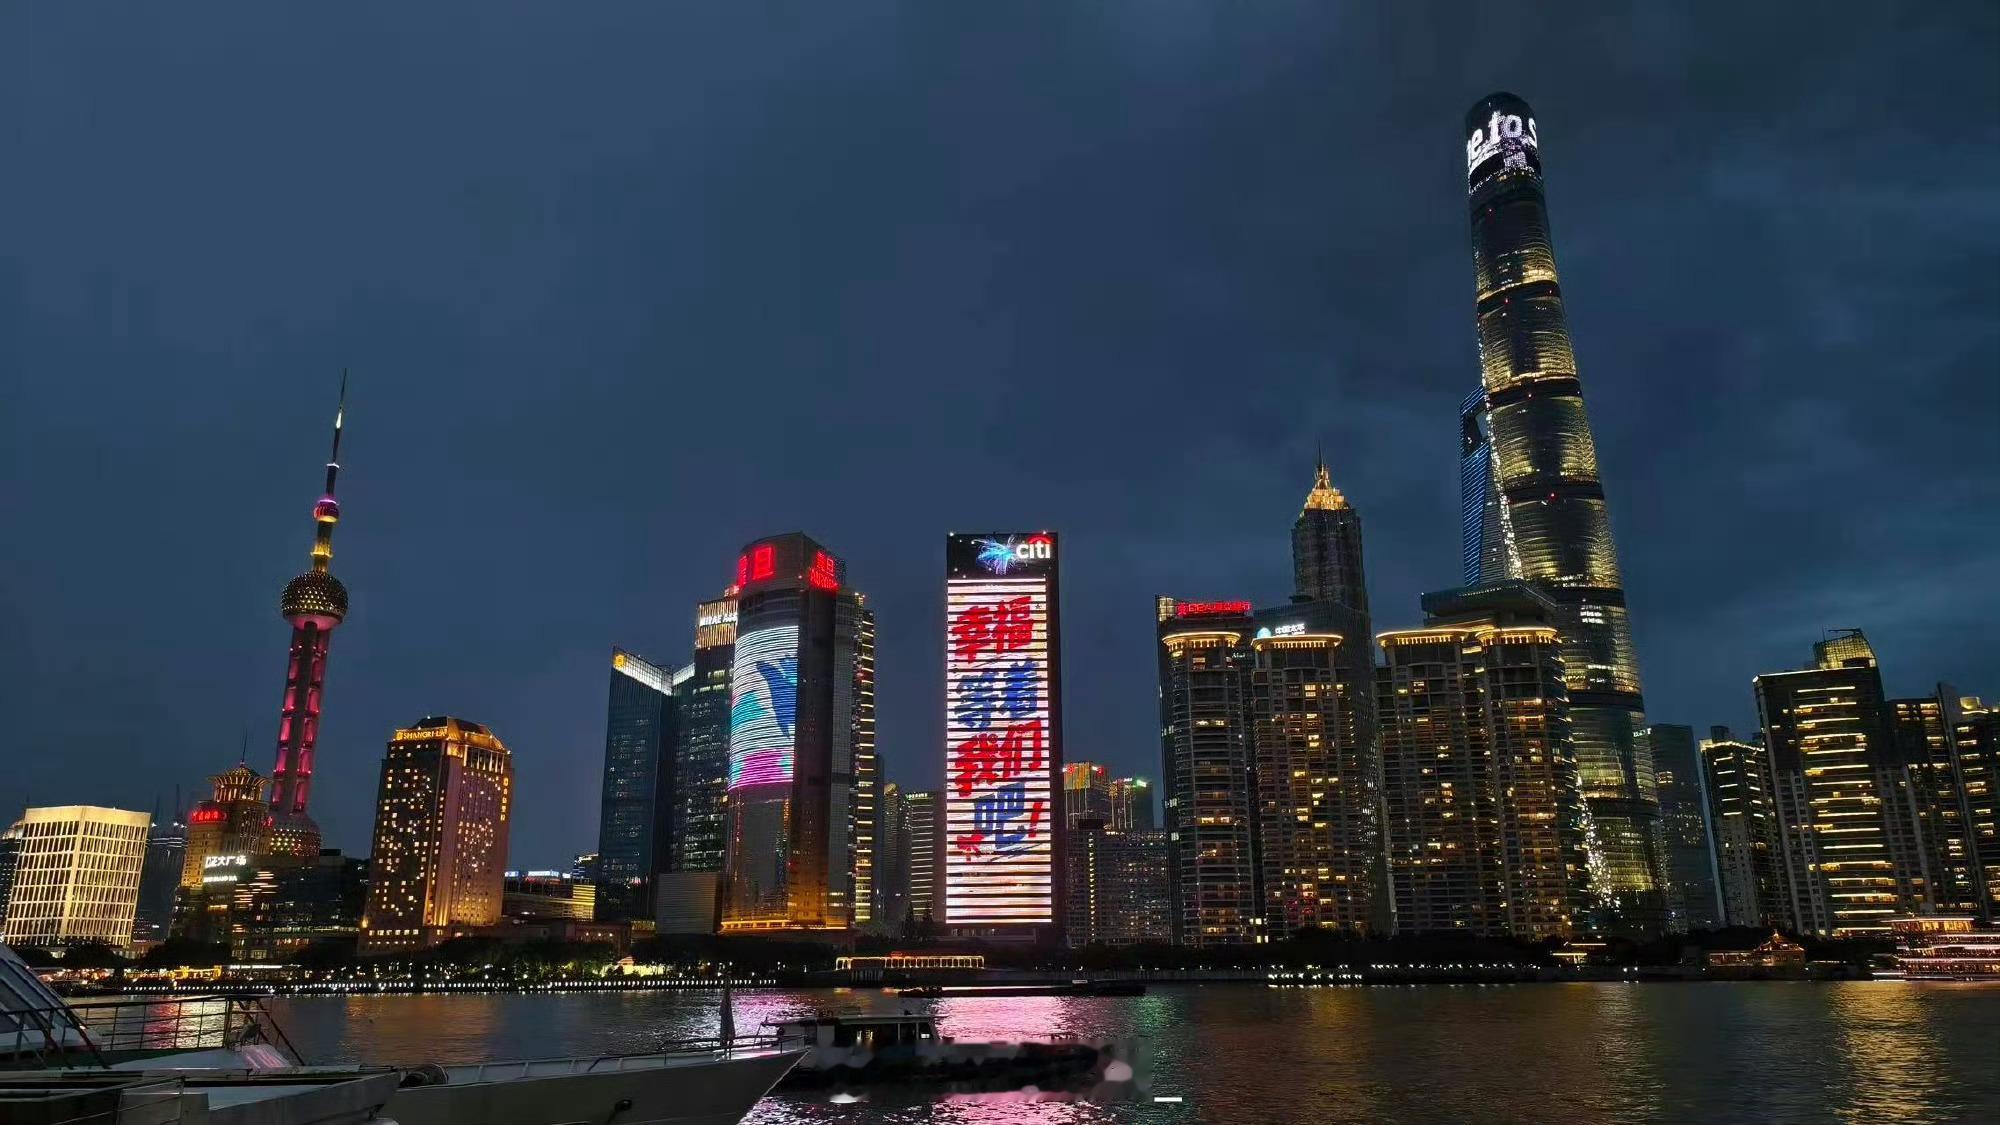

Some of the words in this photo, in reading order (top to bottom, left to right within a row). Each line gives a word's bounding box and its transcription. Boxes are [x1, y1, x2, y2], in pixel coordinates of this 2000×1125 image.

[1016, 539, 1051, 559] citi
[952, 596, 1034, 664] 幸福
[955, 718, 1043, 797] 我们
